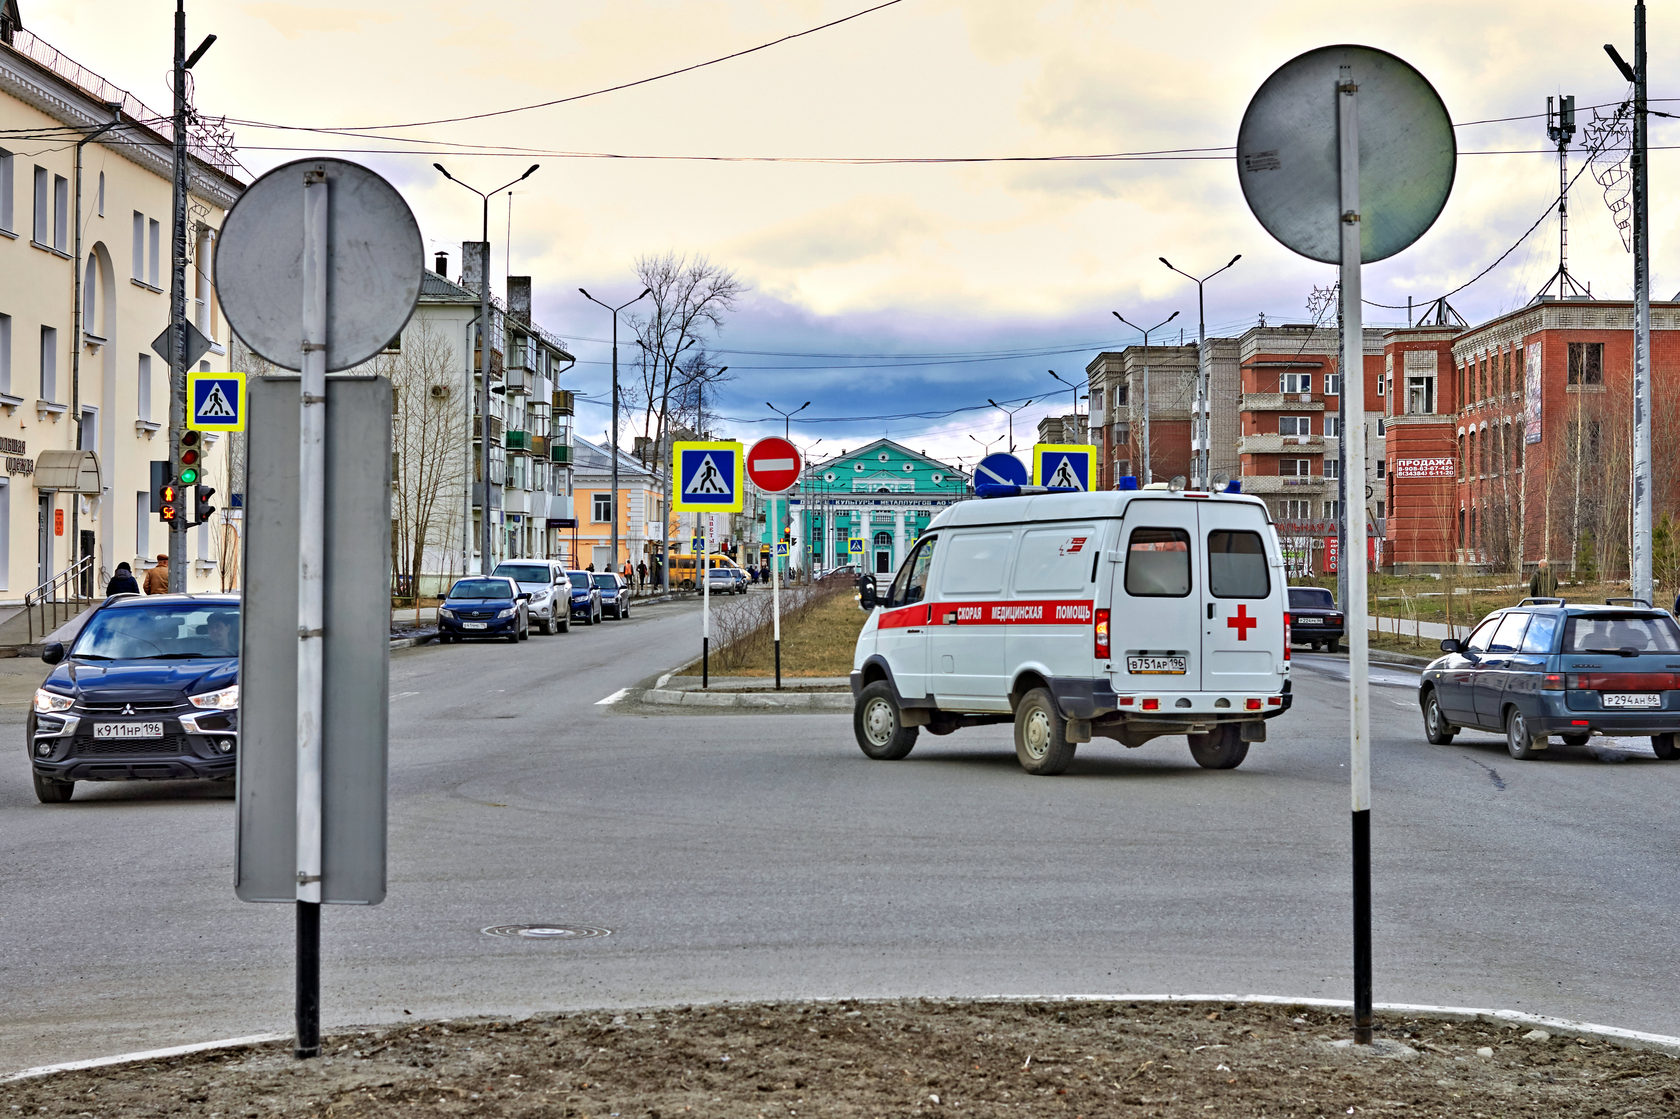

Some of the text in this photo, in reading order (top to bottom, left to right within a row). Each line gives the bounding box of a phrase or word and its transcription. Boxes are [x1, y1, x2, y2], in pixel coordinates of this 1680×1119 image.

[1398, 459, 1453, 467] ПРОДАЖА
[163, 506, 175, 519] 52
[957, 605, 1091, 622] СКОРАЯ МЕДИЦИНСКАЯ ПОМОЩЬ
[1132, 658, 1184, 670] В751АР 196
[1608, 694, 1658, 704] Р294АН 66
[97, 724, 160, 736] К911НР 196
